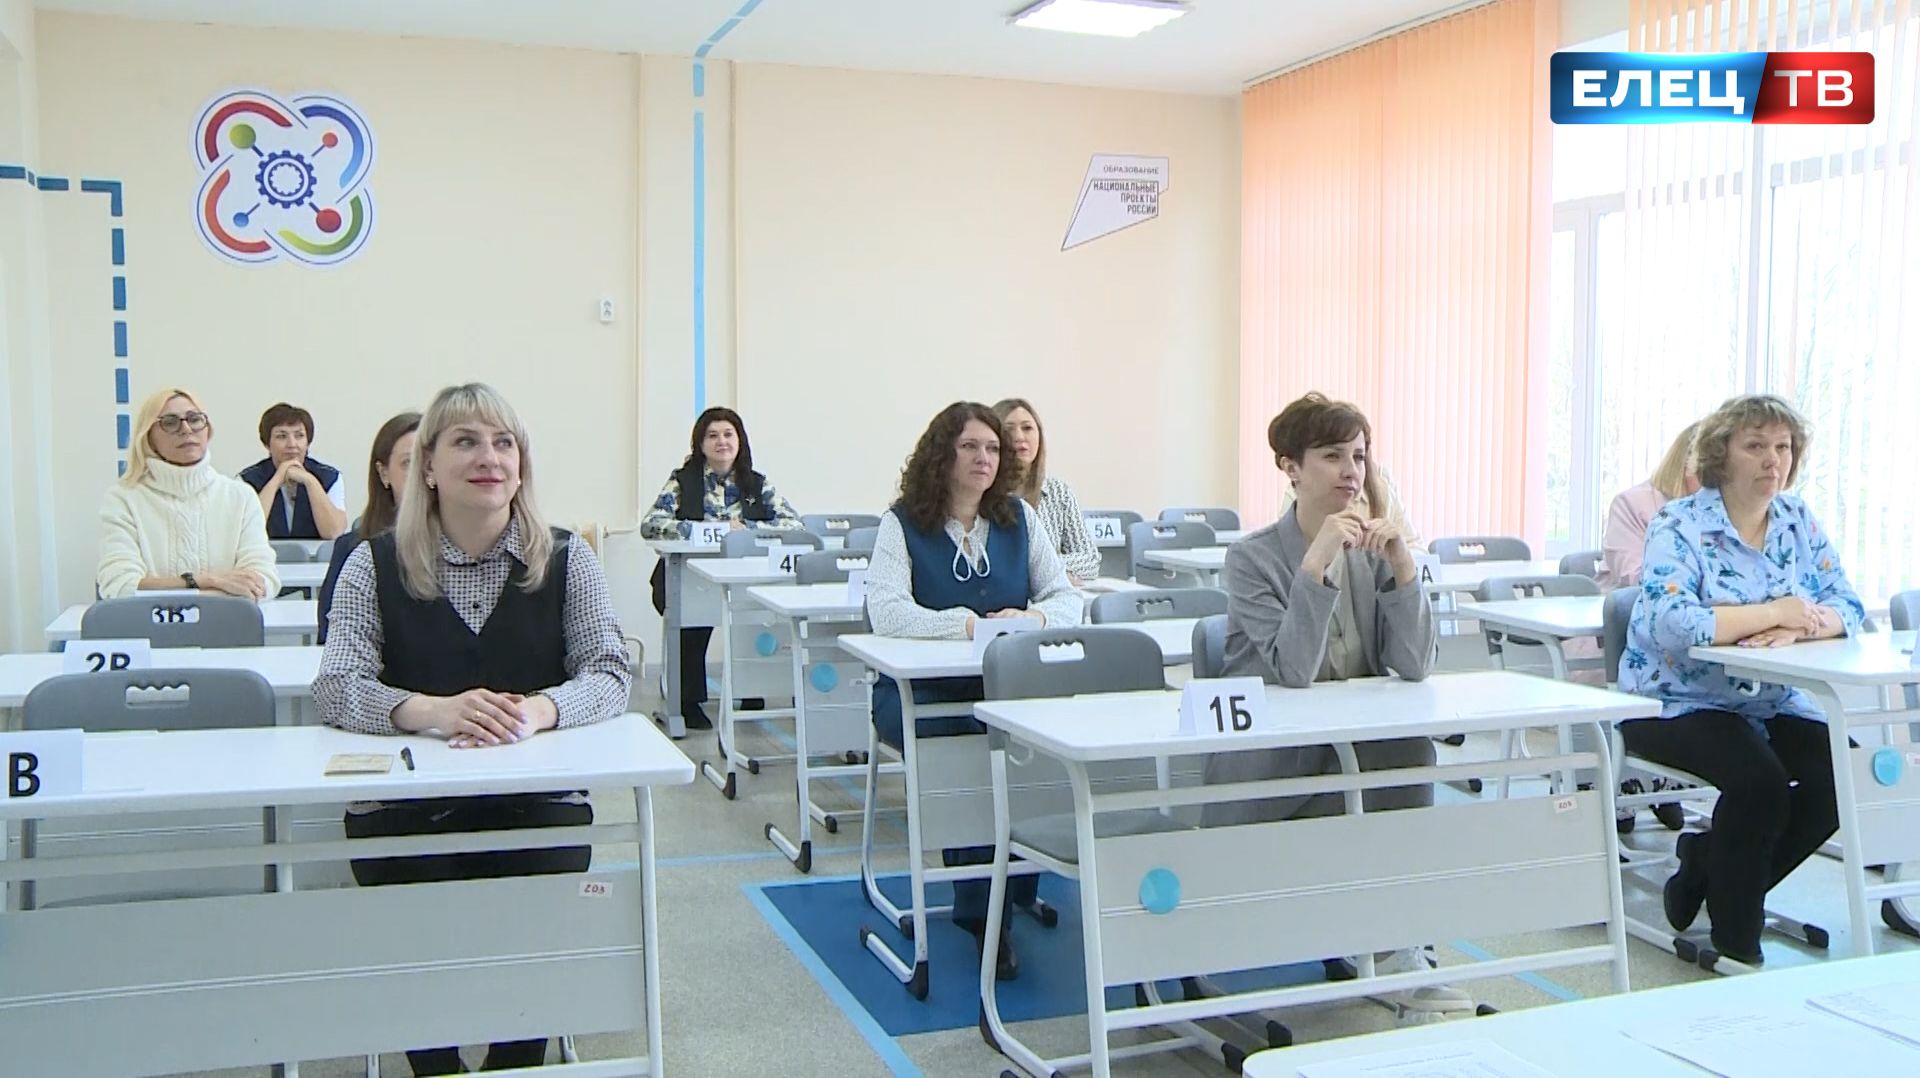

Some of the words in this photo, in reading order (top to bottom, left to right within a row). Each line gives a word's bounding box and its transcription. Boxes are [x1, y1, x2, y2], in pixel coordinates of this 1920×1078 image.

[1103, 164, 1159, 174] ОБРАЗОВАНИЕ
[1093, 181, 1157, 193] НАЦИОНАЛЬНЫЕ
[1120, 193, 1157, 203] ПРОЕКТЫ
[1127, 204, 1157, 214] РОССИИ
[1094, 523, 1115, 539] 5А
[1209, 695, 1252, 732] 1Б
